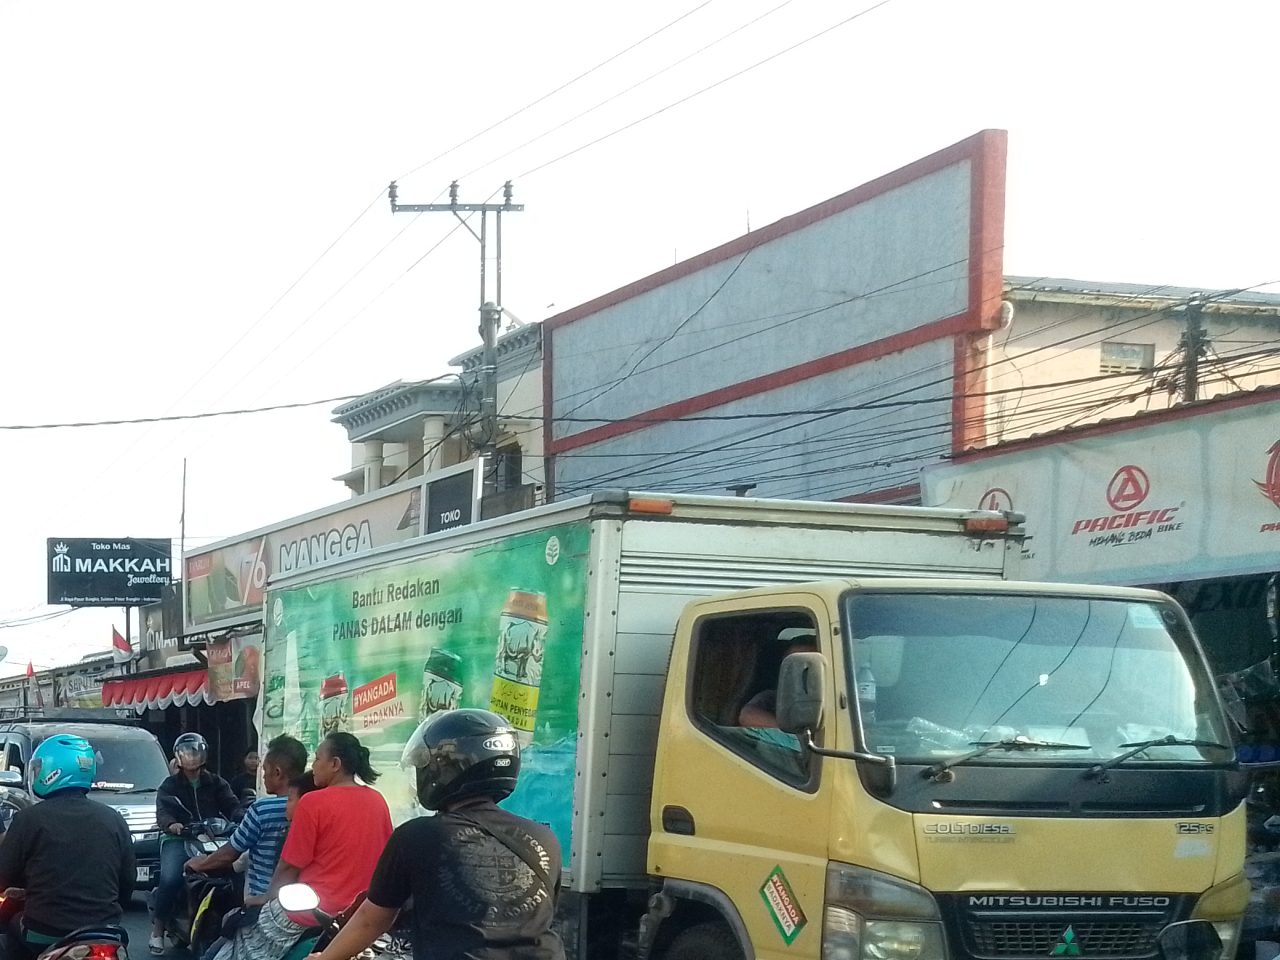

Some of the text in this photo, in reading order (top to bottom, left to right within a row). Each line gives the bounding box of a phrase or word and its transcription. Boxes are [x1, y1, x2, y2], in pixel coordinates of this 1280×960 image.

[440, 509, 461, 525] TOKO
[1072, 507, 1179, 536] PACIFIC
[1128, 528, 1152, 543] BEDA
[1157, 521, 1184, 534] BIKE
[91, 542, 131, 550] Toko Mas
[280, 519, 373, 573] MANGGA
[75, 557, 171, 573] MAKKAH
[126, 573, 171, 587] Jewellery
[352, 577, 440, 609] Bantu Redakan
[332, 607, 463, 642] PANAS DALAM dengan
[353, 679, 395, 708] #YANGADA
[363, 700, 405, 729] BADAKNYA
[923, 822, 1215, 835] COLT DIESEL 125PS
[969, 895, 1170, 907] MITSUBISHI FUSO
